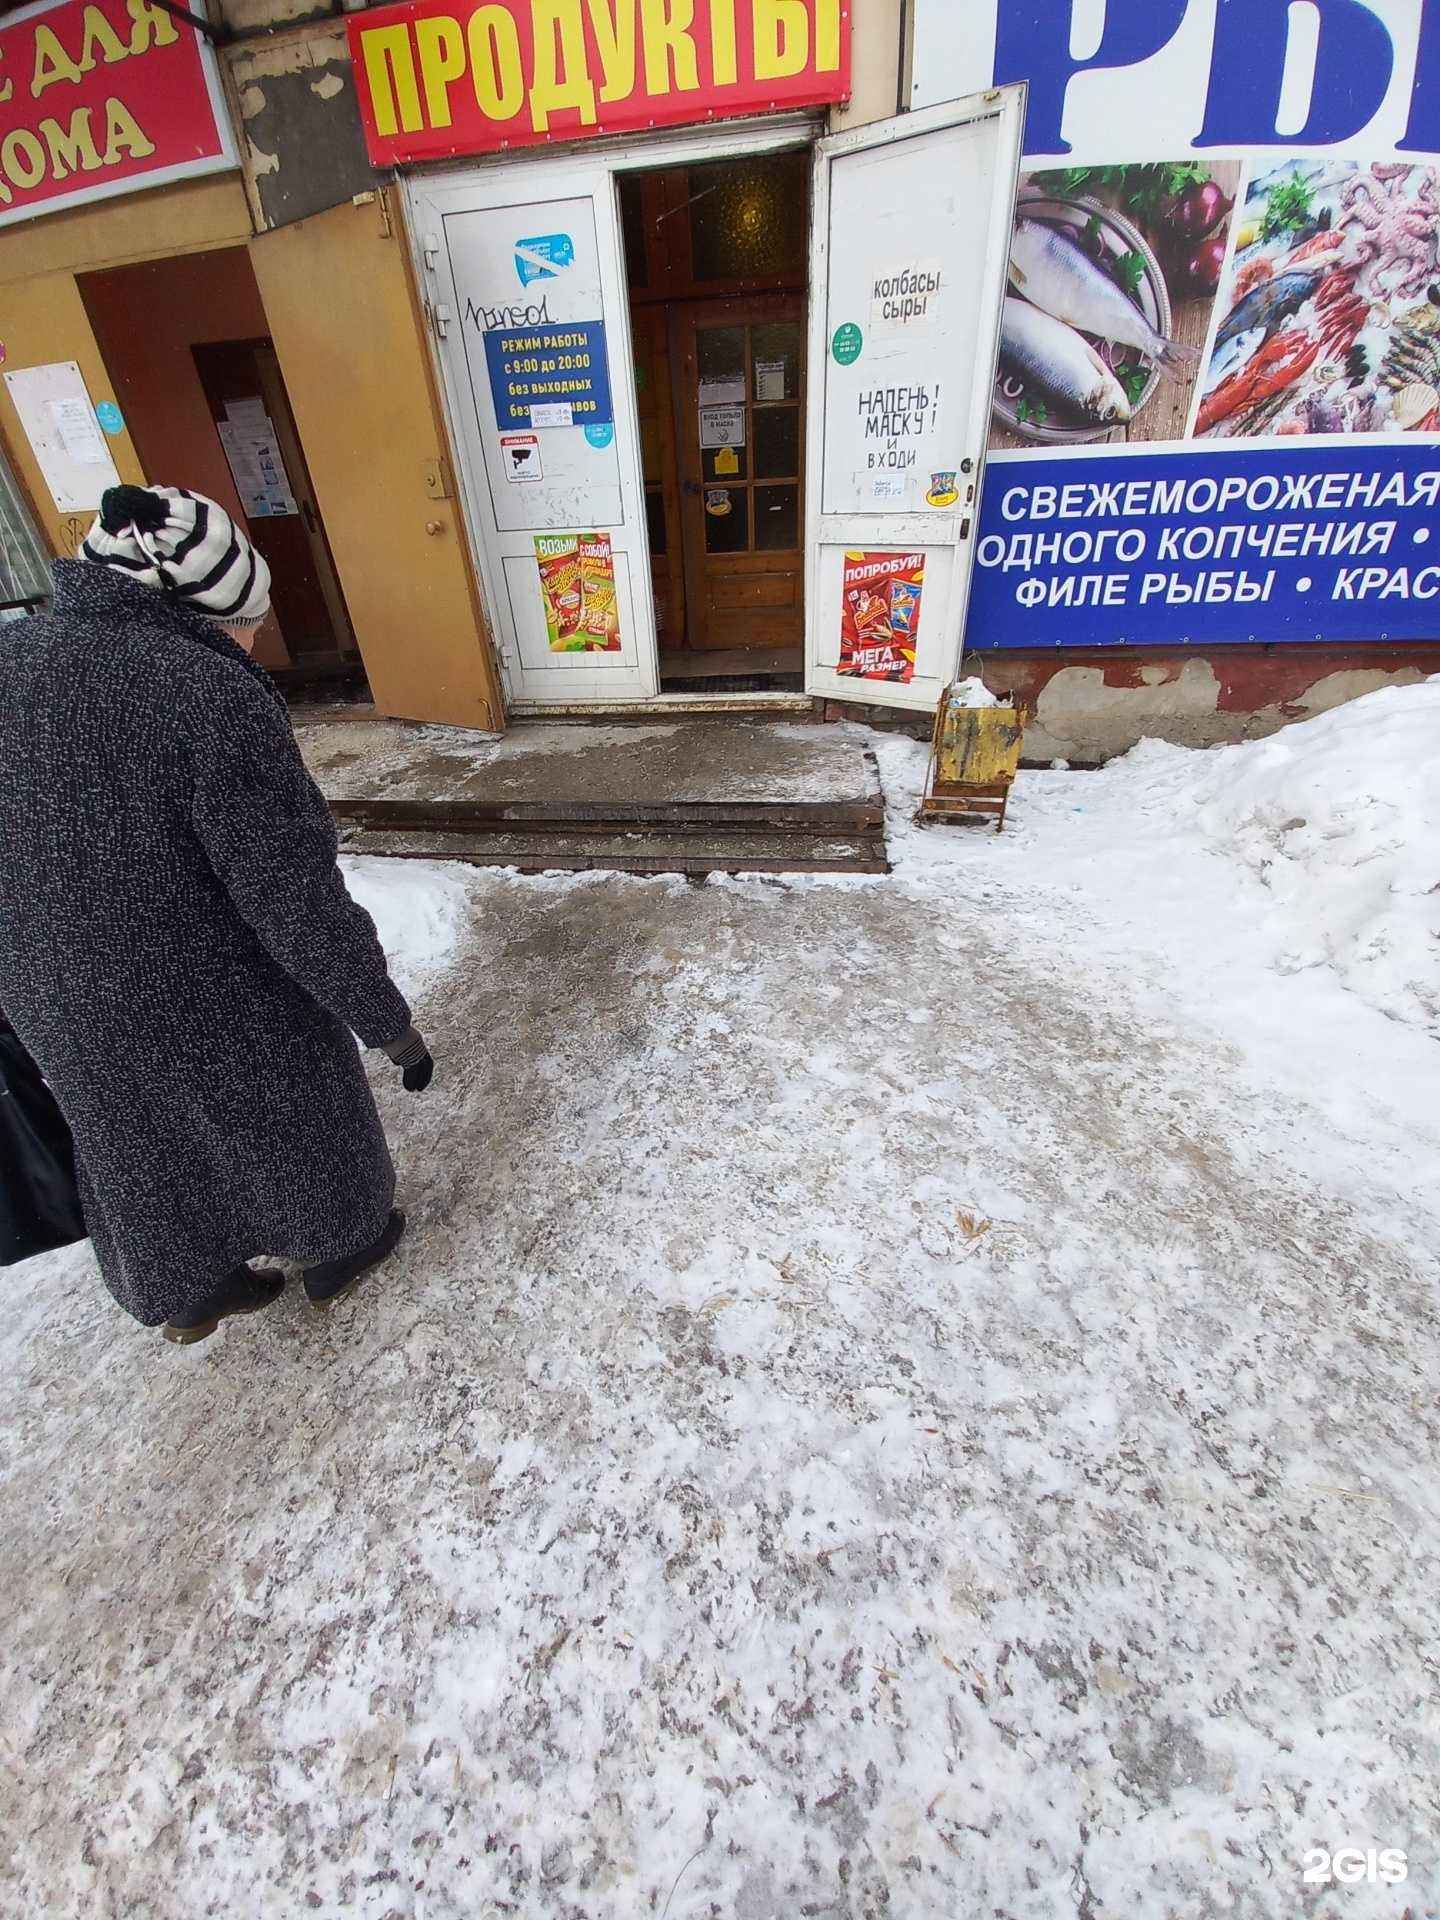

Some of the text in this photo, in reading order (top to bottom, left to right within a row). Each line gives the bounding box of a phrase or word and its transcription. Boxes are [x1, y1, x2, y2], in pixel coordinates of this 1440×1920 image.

[31, 0, 180, 98] ДЛЯ
[361, 0, 841, 136] ПРОДУКТЫ
[874, 269, 941, 299] колбасы
[882, 296, 927, 323] сыры
[501, 333, 588, 352] РЕЖИМ РАБОТЫ
[504, 354, 590, 374] с 9:00 до 20:00
[508, 378, 592, 396] без выходных
[510, 404, 530, 417] без
[868, 450, 916, 469] ВХОДИ
[1001, 471, 1440, 521] СВЕЖЕМОРОЖЕНАЯ
[539, 538, 577, 557] ВОЗЬМИ
[977, 520, 1398, 573] ОДНОГО КОПЧЕНИЯ
[845, 554, 923, 582] ПОПРОБУЙ!
[1015, 565, 1440, 608] ФИЛЕ РЫБЫ КРАС
[852, 646, 896, 666] МЕГА
[860, 659, 908, 674] РАЗМЕР
